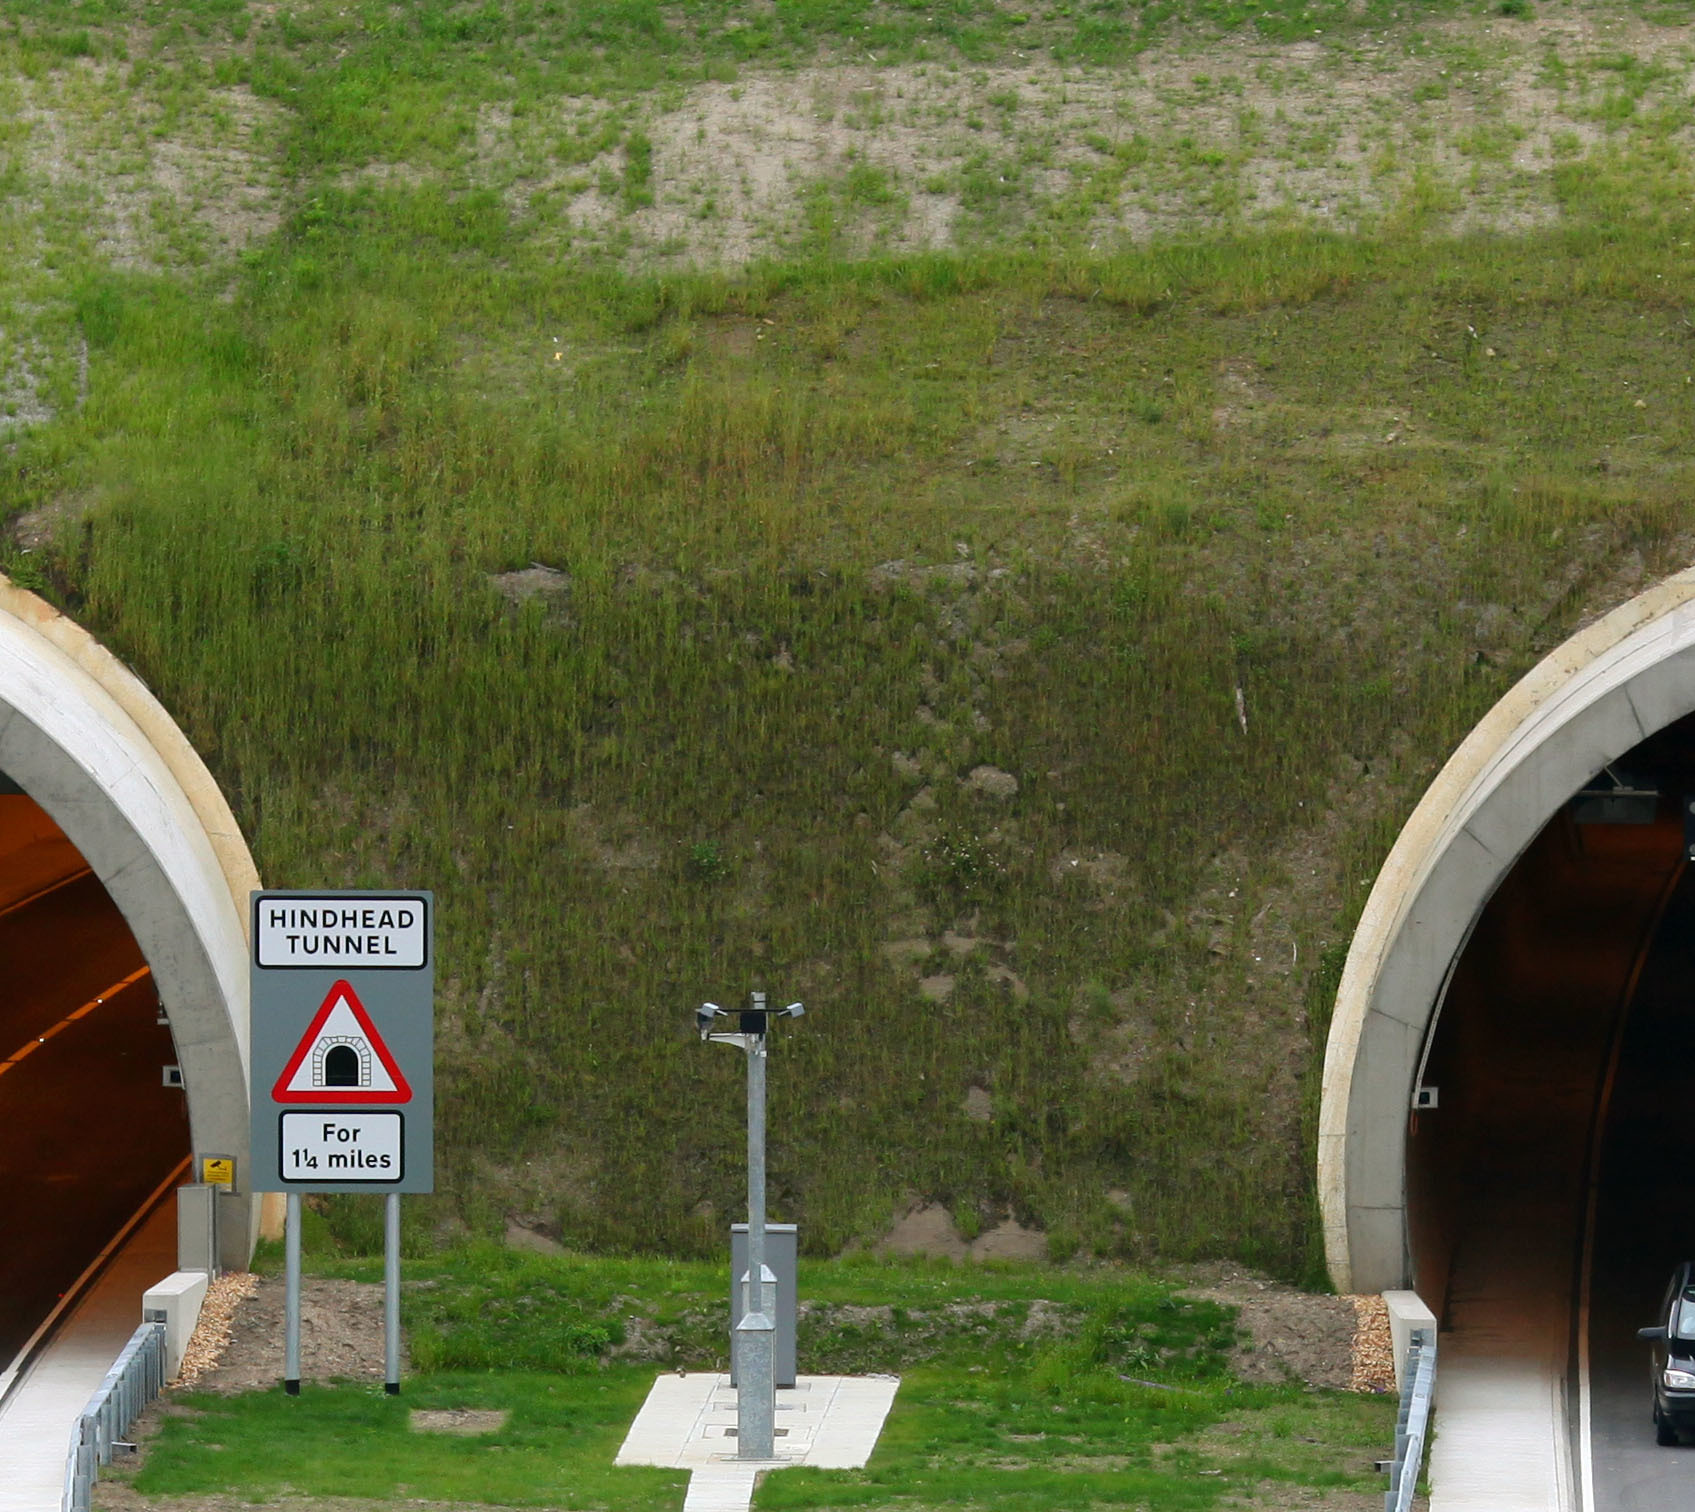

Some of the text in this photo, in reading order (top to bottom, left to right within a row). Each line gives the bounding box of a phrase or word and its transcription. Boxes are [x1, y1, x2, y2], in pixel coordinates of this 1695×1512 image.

[270, 909, 415, 929] HINDHEAD
[286, 935, 398, 955] TUNNEL
[322, 1123, 362, 1143] For
[328, 1150, 392, 1169] miles
